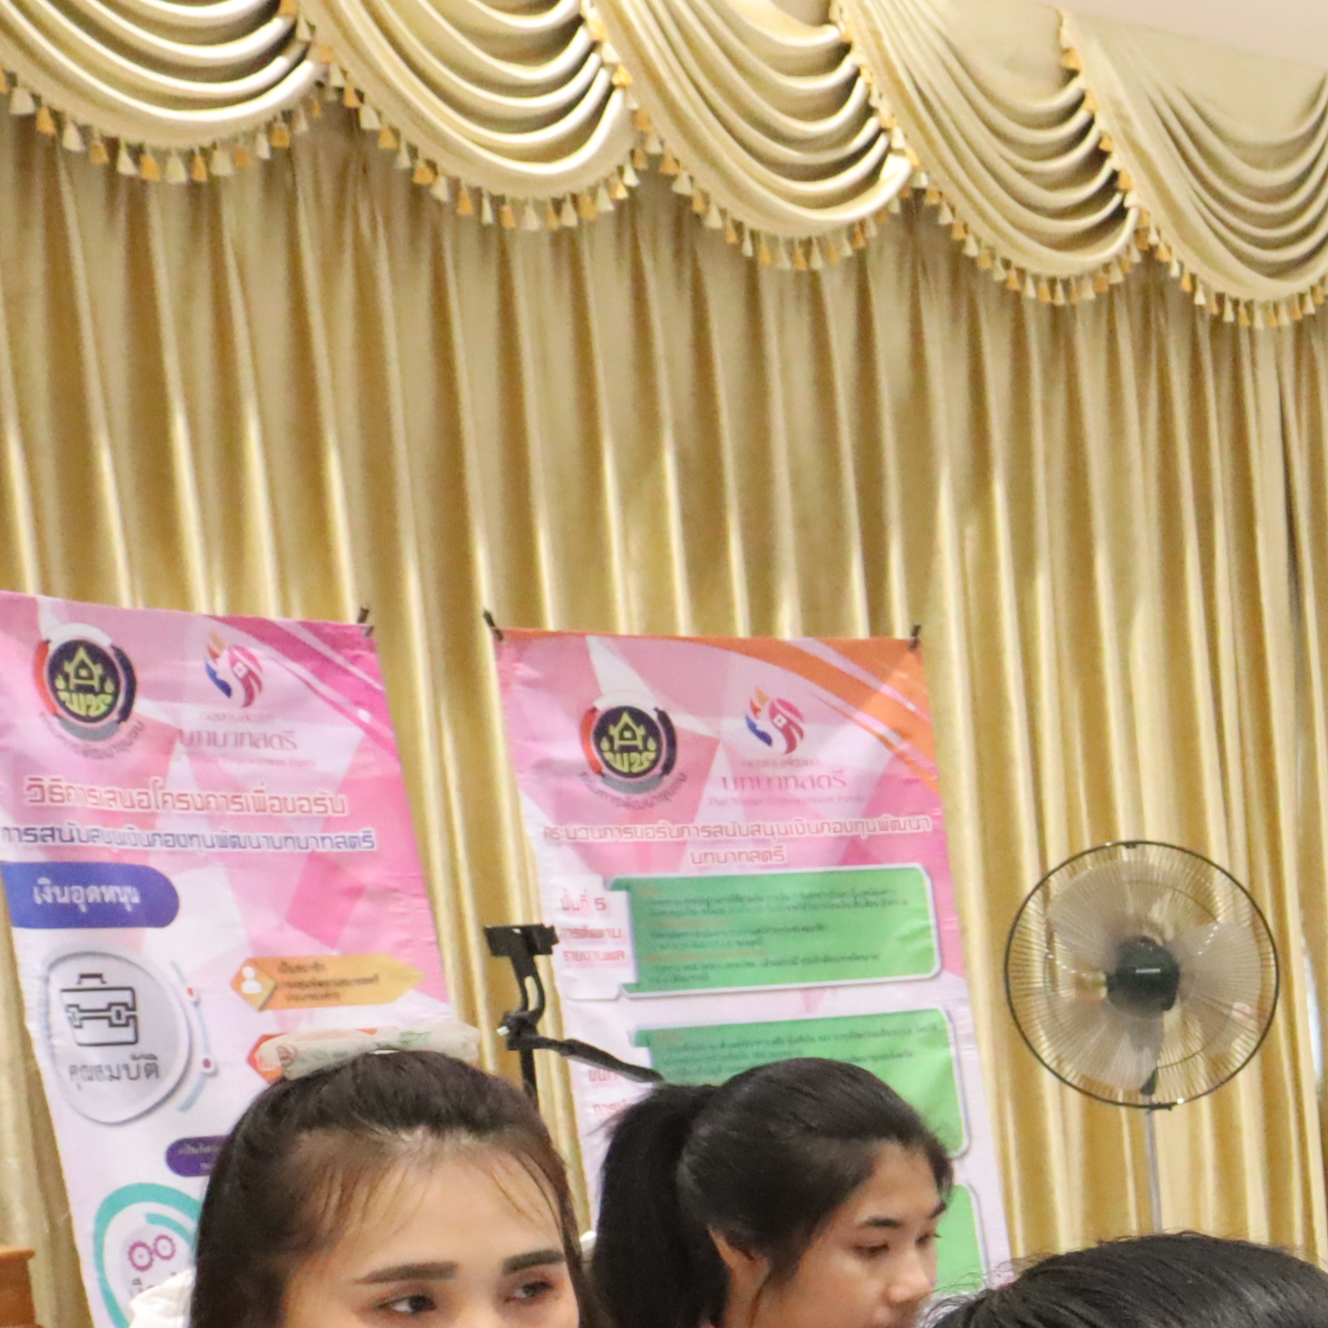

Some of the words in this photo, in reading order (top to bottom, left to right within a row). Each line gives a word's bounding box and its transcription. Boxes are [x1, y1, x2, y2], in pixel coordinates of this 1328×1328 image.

[721, 769, 847, 791] บทบาทสตรี
[690, 845, 786, 867] บทบาทสตรี
[594, 896, 607, 912] 5
[69, 1053, 160, 1092] คุณสมบัติ
